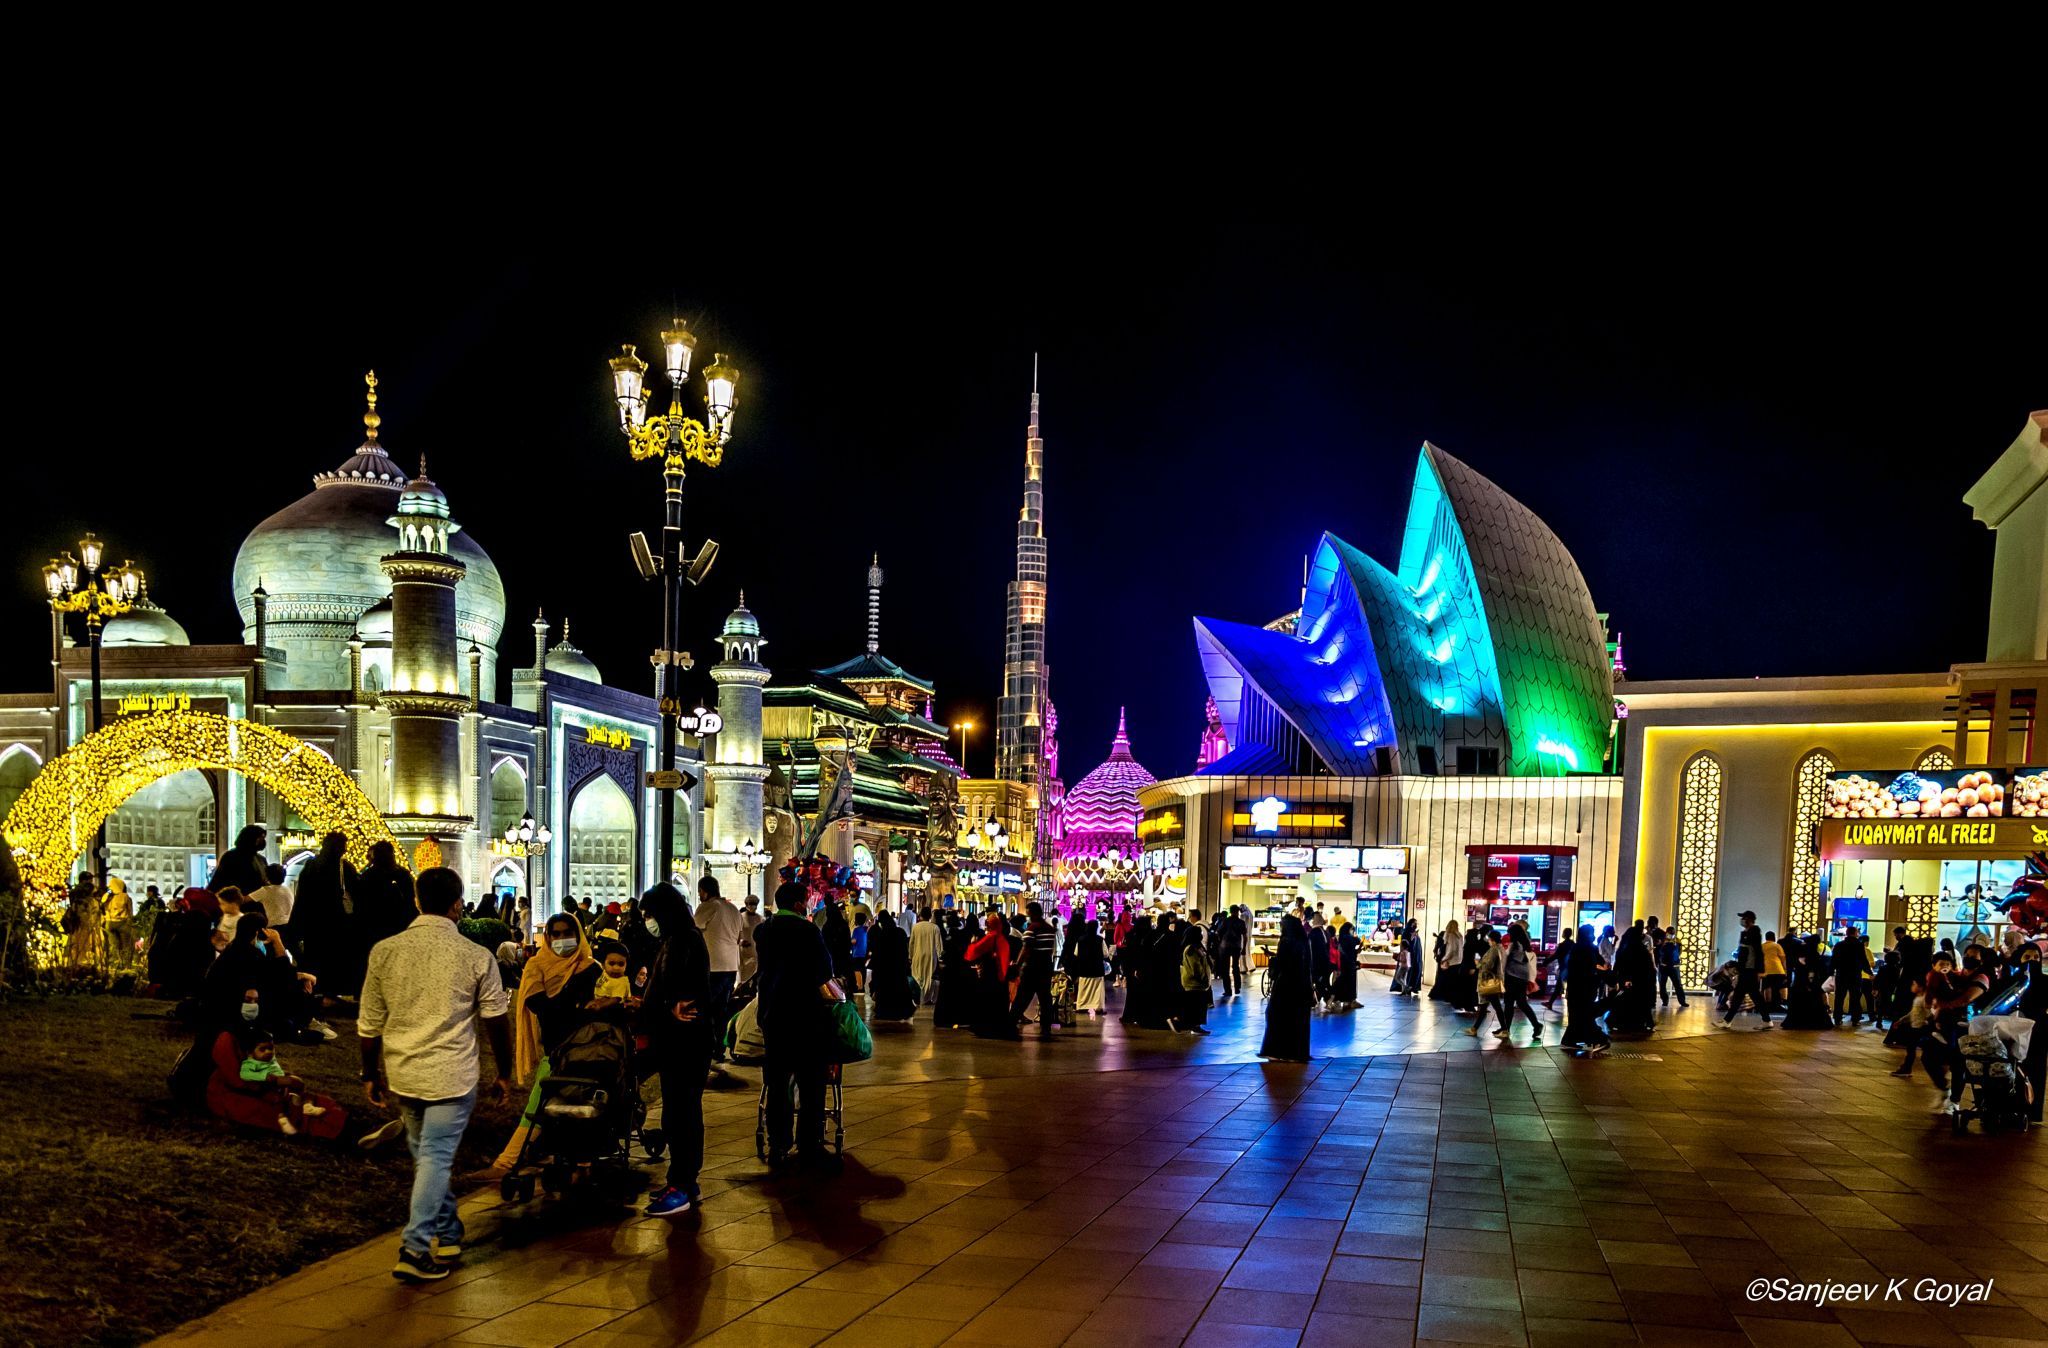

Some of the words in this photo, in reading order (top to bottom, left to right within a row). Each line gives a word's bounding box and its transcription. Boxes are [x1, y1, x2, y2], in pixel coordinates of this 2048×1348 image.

[1844, 824, 1925, 846] LUQAYMAT
[1927, 823, 1948, 845] AL
[1951, 823, 1996, 845] FREEJ
[1416, 900, 1425, 908] 25
